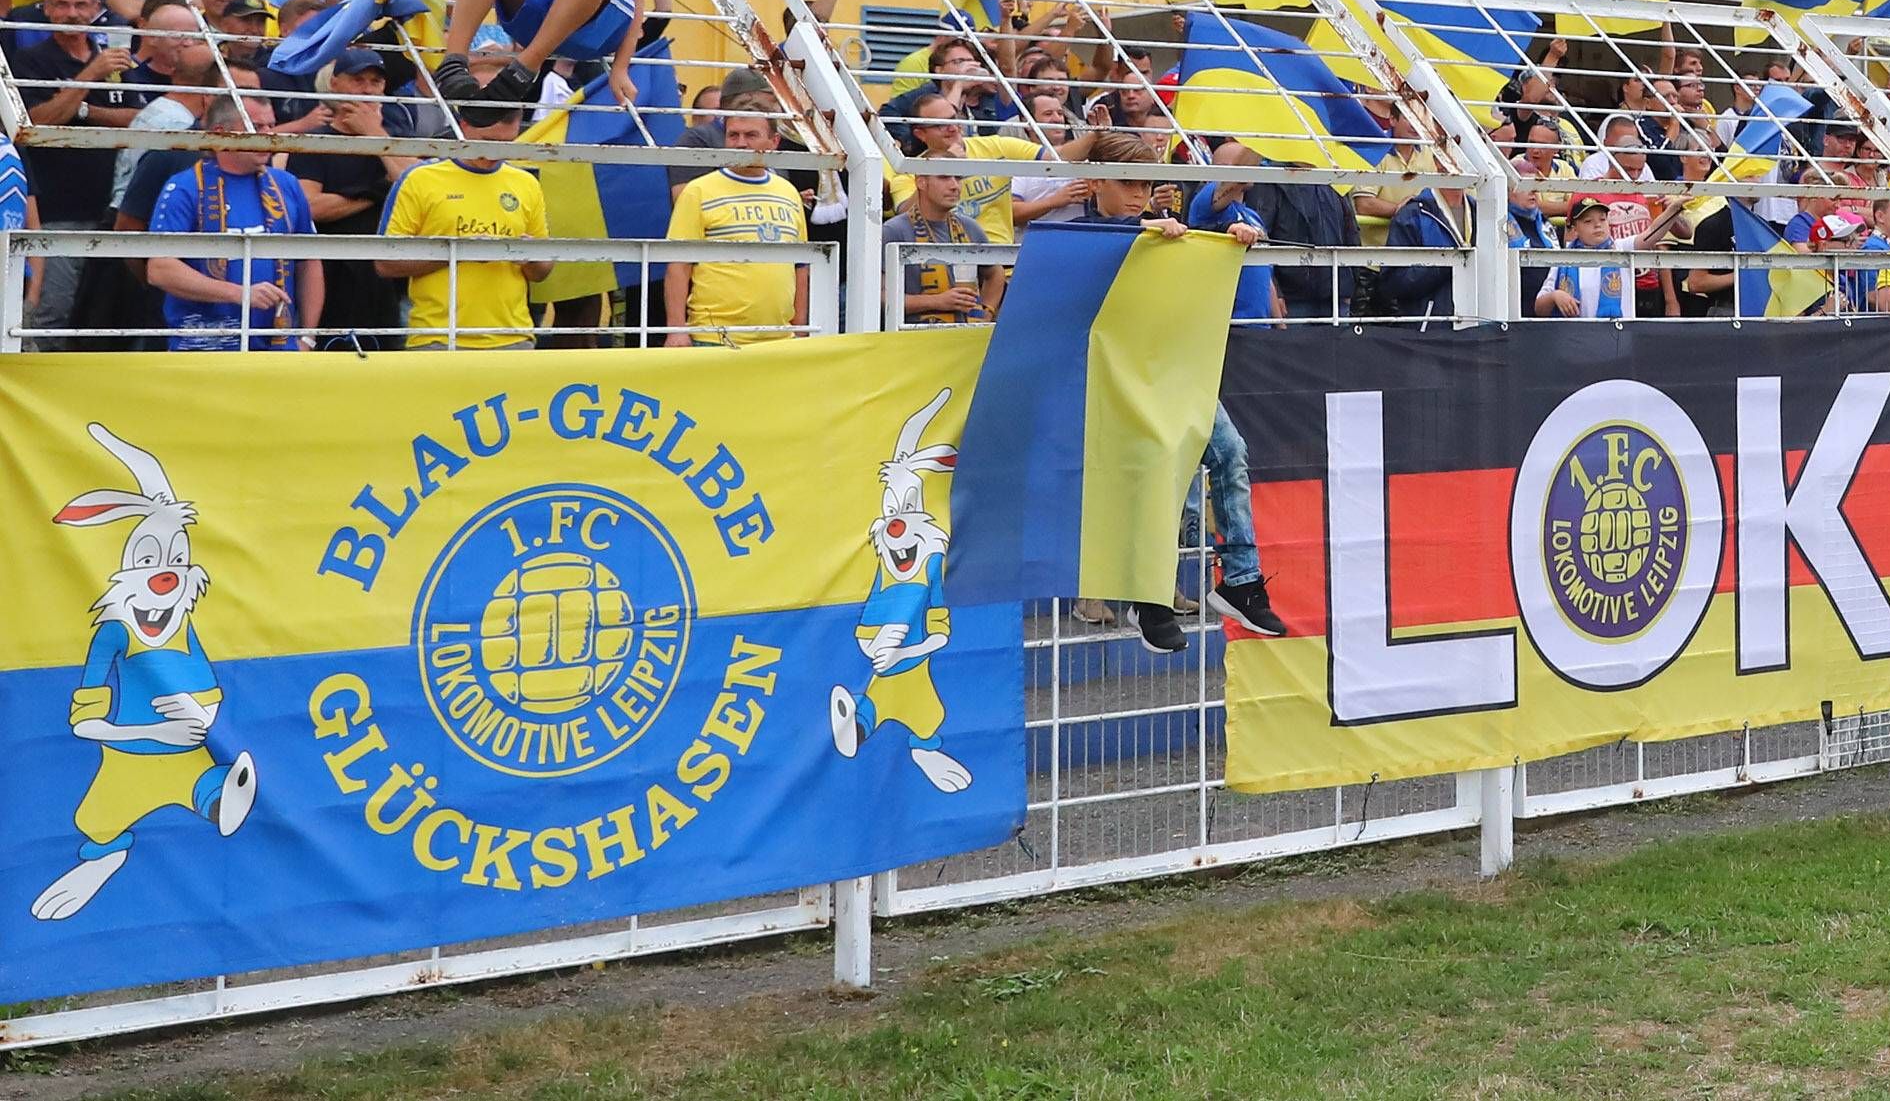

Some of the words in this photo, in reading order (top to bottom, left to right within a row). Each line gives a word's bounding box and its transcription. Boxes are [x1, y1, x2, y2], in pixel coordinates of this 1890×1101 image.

[732, 205, 764, 221] 1.FC
[965, 175, 993, 197] LOK
[316, 382, 776, 593] BLAU-GELBE
[1568, 432, 1663, 501] 1.FC
[499, 500, 620, 557] 1.FC
[1551, 519, 1640, 625] LOKOMOTIVE
[1639, 506, 1680, 607] LEIPZIG
[430, 622, 596, 765] LOKOMOTIVE
[595, 604, 680, 741] LEIPZIG
[307, 634, 783, 892] GLÜCKSHASEN
